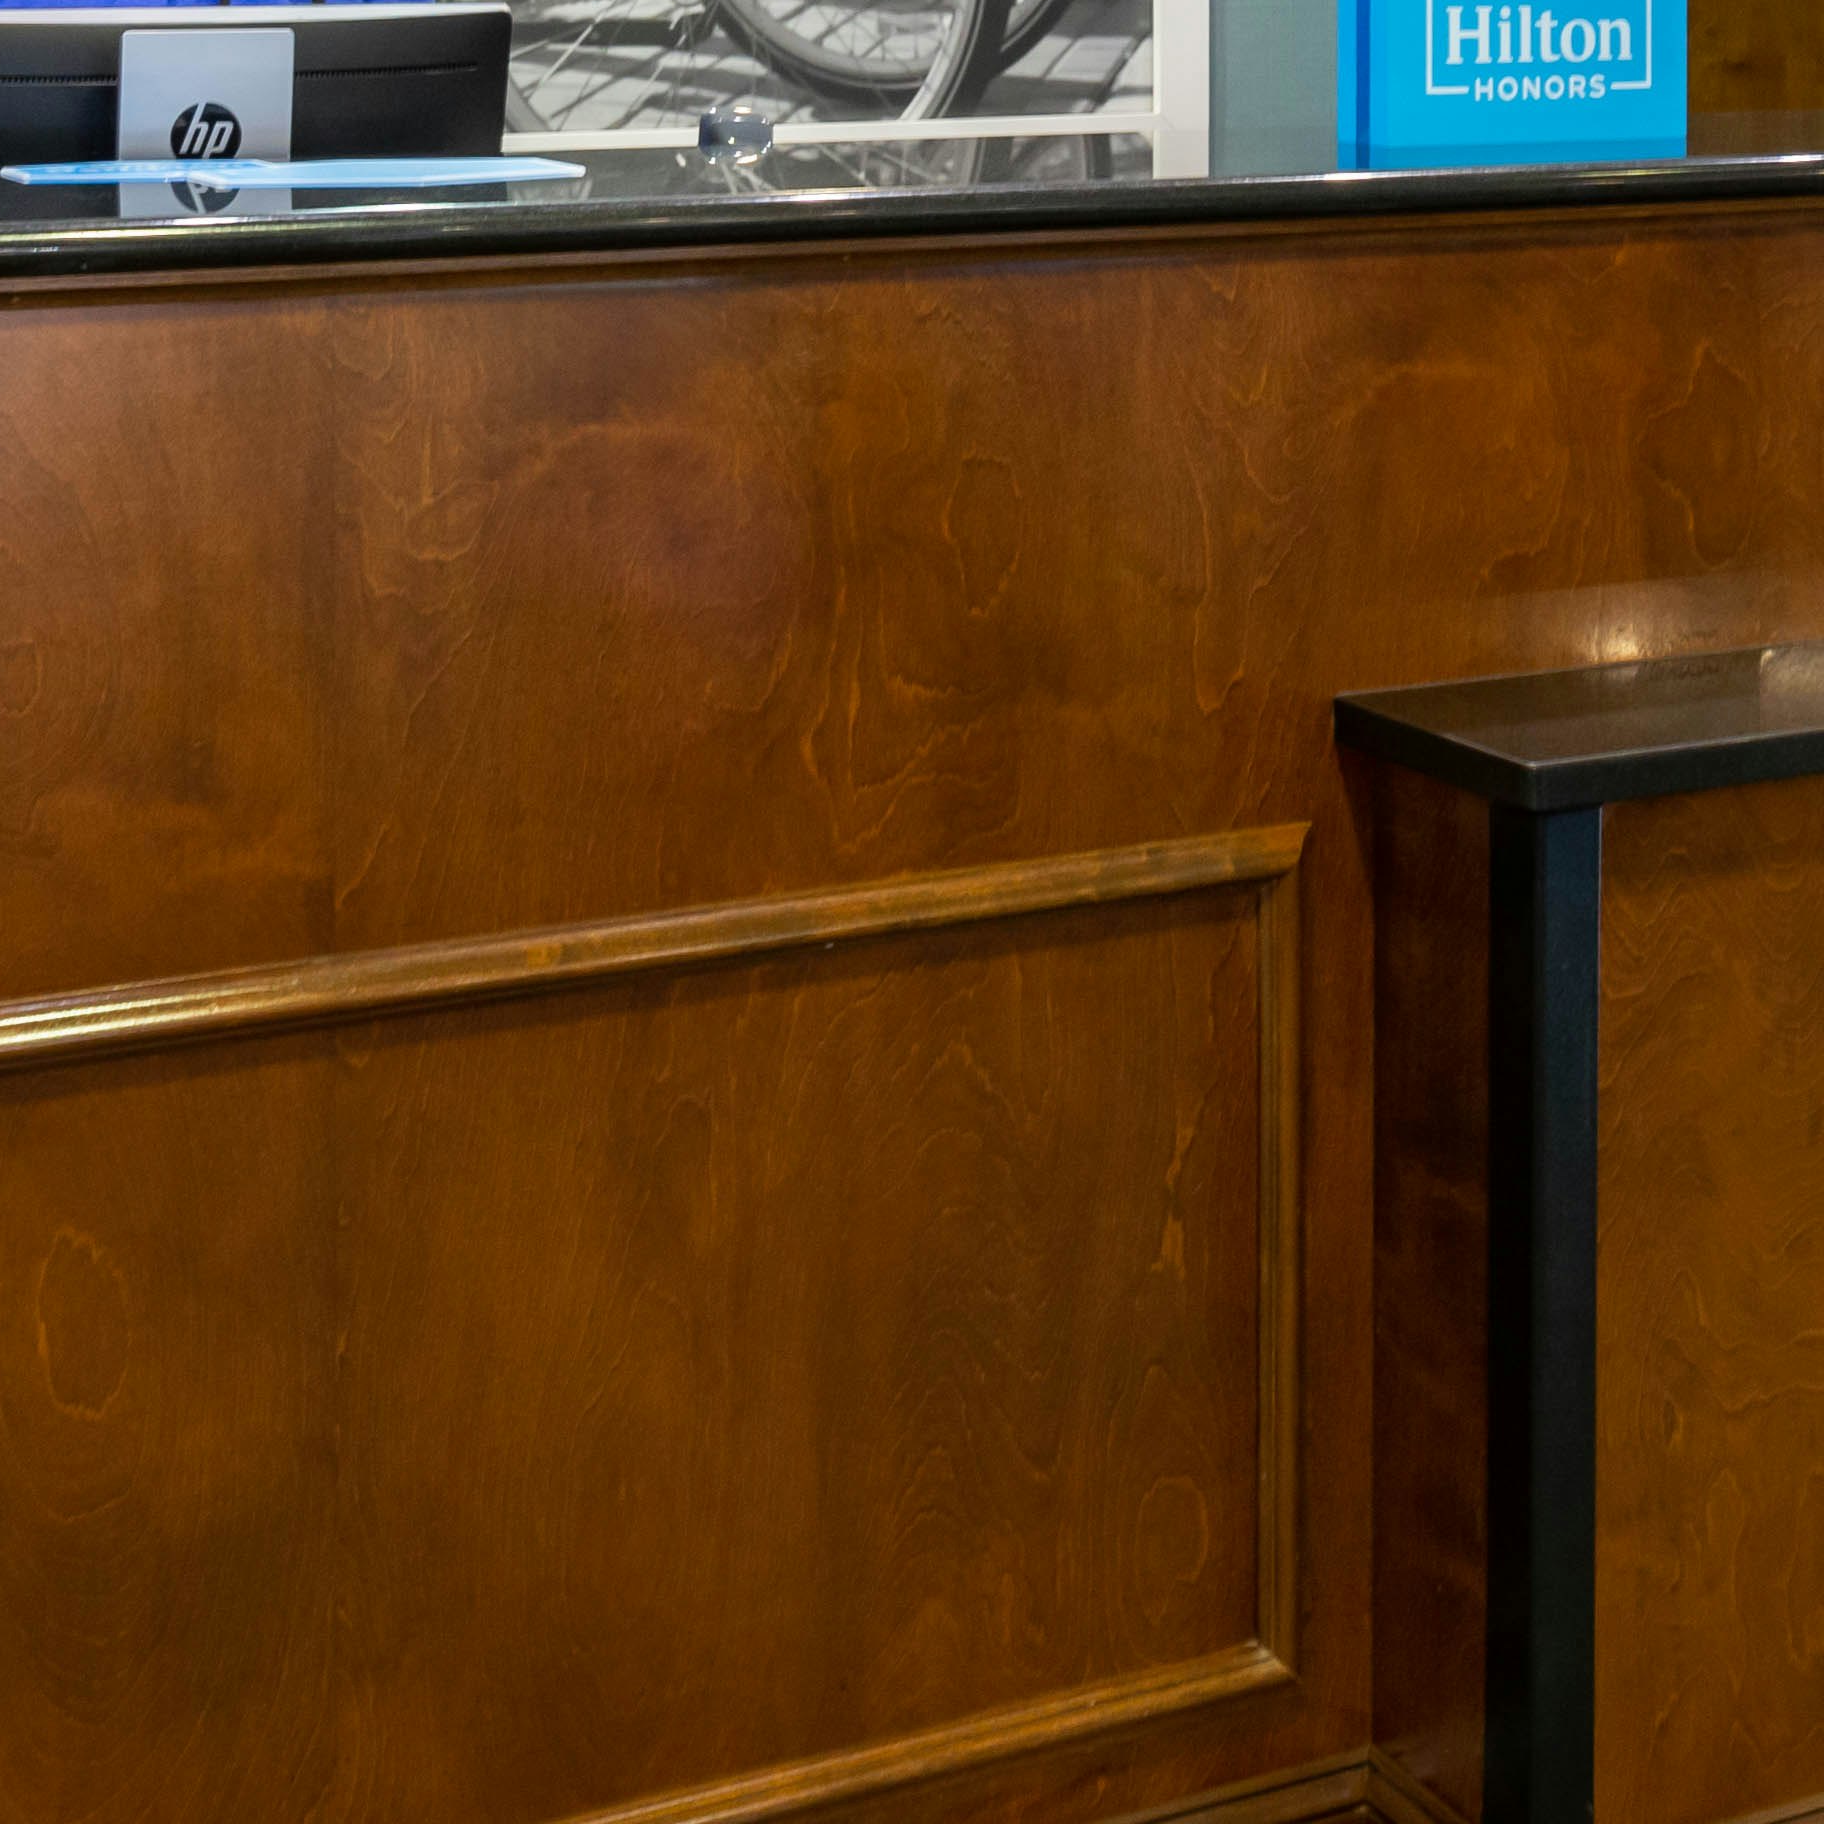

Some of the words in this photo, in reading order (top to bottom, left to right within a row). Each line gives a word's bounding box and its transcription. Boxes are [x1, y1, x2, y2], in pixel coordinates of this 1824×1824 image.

[1445, 4, 1632, 65] Hilton
[1475, 73, 1607, 102] HONORS
[179, 102, 234, 159] hp
